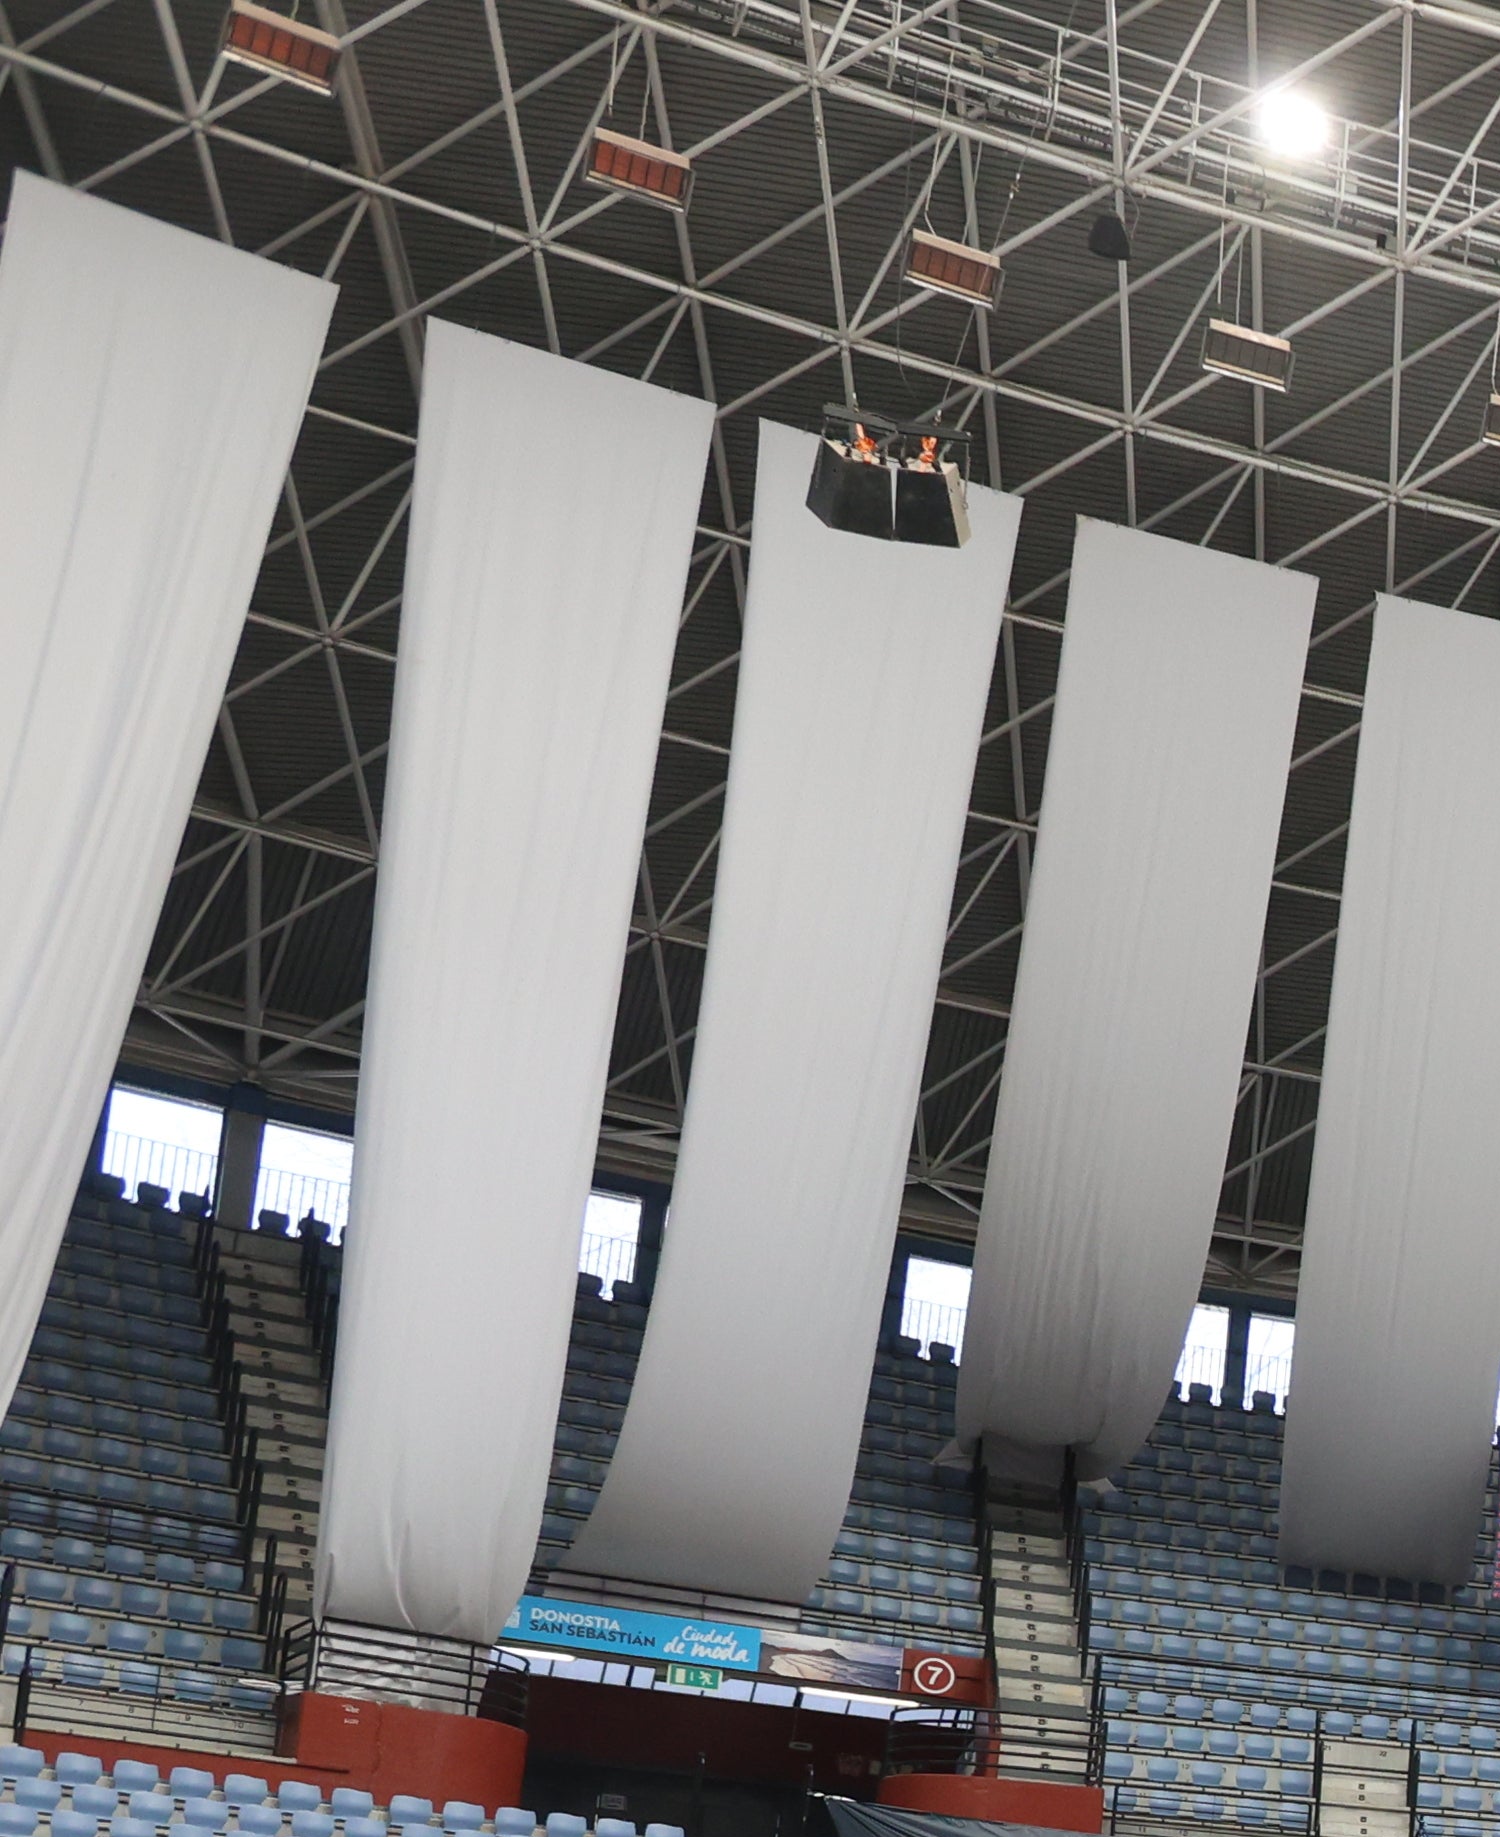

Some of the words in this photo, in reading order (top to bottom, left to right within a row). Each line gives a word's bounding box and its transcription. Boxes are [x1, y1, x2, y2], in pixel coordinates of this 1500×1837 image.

[531, 1606, 620, 1631] DONOSTIA
[529, 1619, 564, 1636] SAN
[565, 1622, 656, 1648] SEBASTIÁN
[663, 1637, 687, 1655] de
[690, 1642, 751, 1664] moda
[925, 1665, 946, 1687] 7
